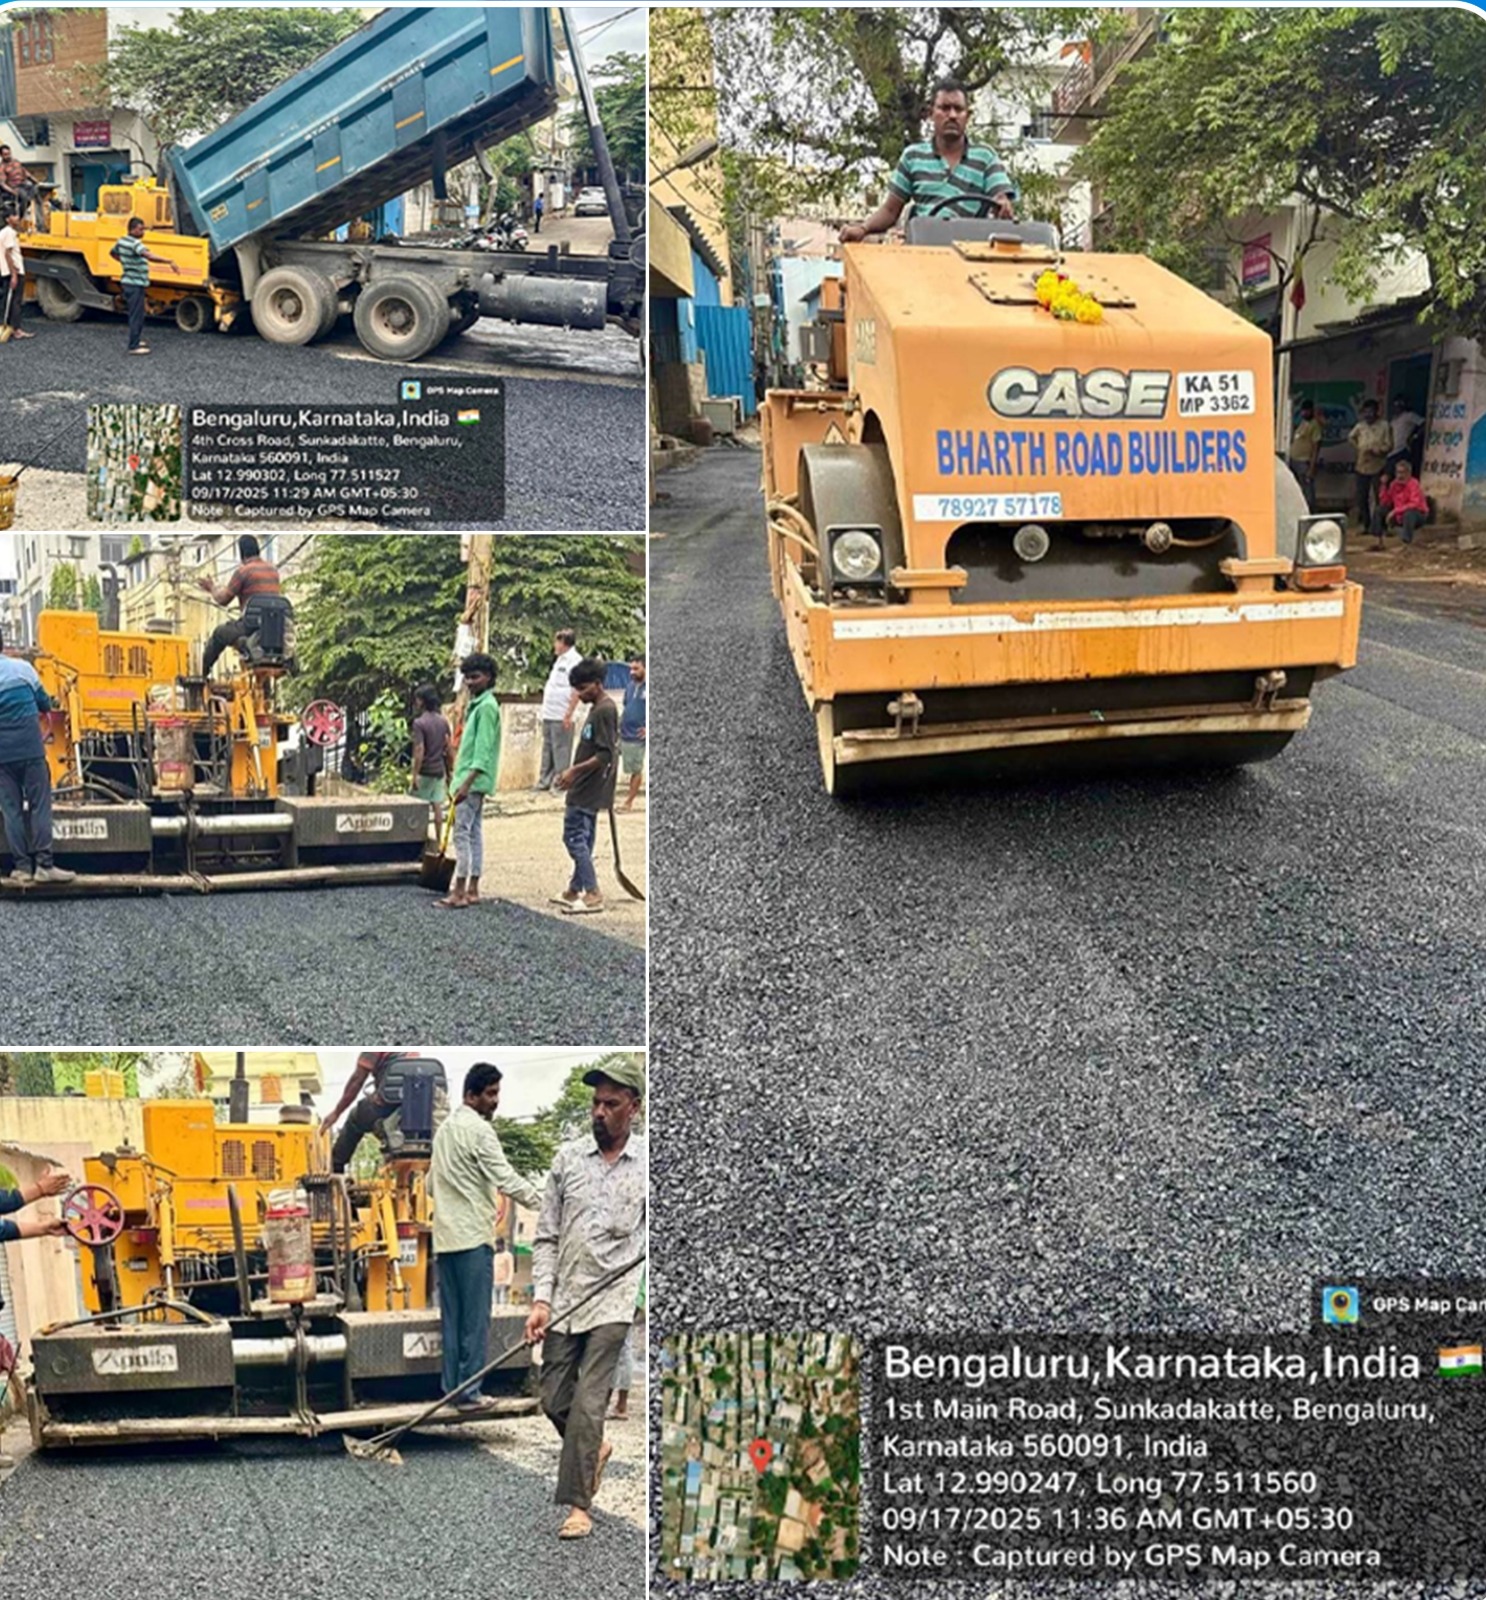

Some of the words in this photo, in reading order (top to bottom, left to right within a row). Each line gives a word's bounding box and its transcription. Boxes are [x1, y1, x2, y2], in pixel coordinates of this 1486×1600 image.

[987, 366, 1172, 419] CASE
[1185, 376, 1212, 393] KA
[1218, 374, 1240, 391] 51
[1179, 397, 1204, 413] MP
[1209, 395, 1251, 412] 3362
[936, 430, 1046, 477] BHARTH
[1056, 430, 1123, 476] ROAD
[1128, 429, 1247, 475] BUILDERS
[938, 498, 998, 517] 78927
[1004, 496, 1062, 516] 57178
